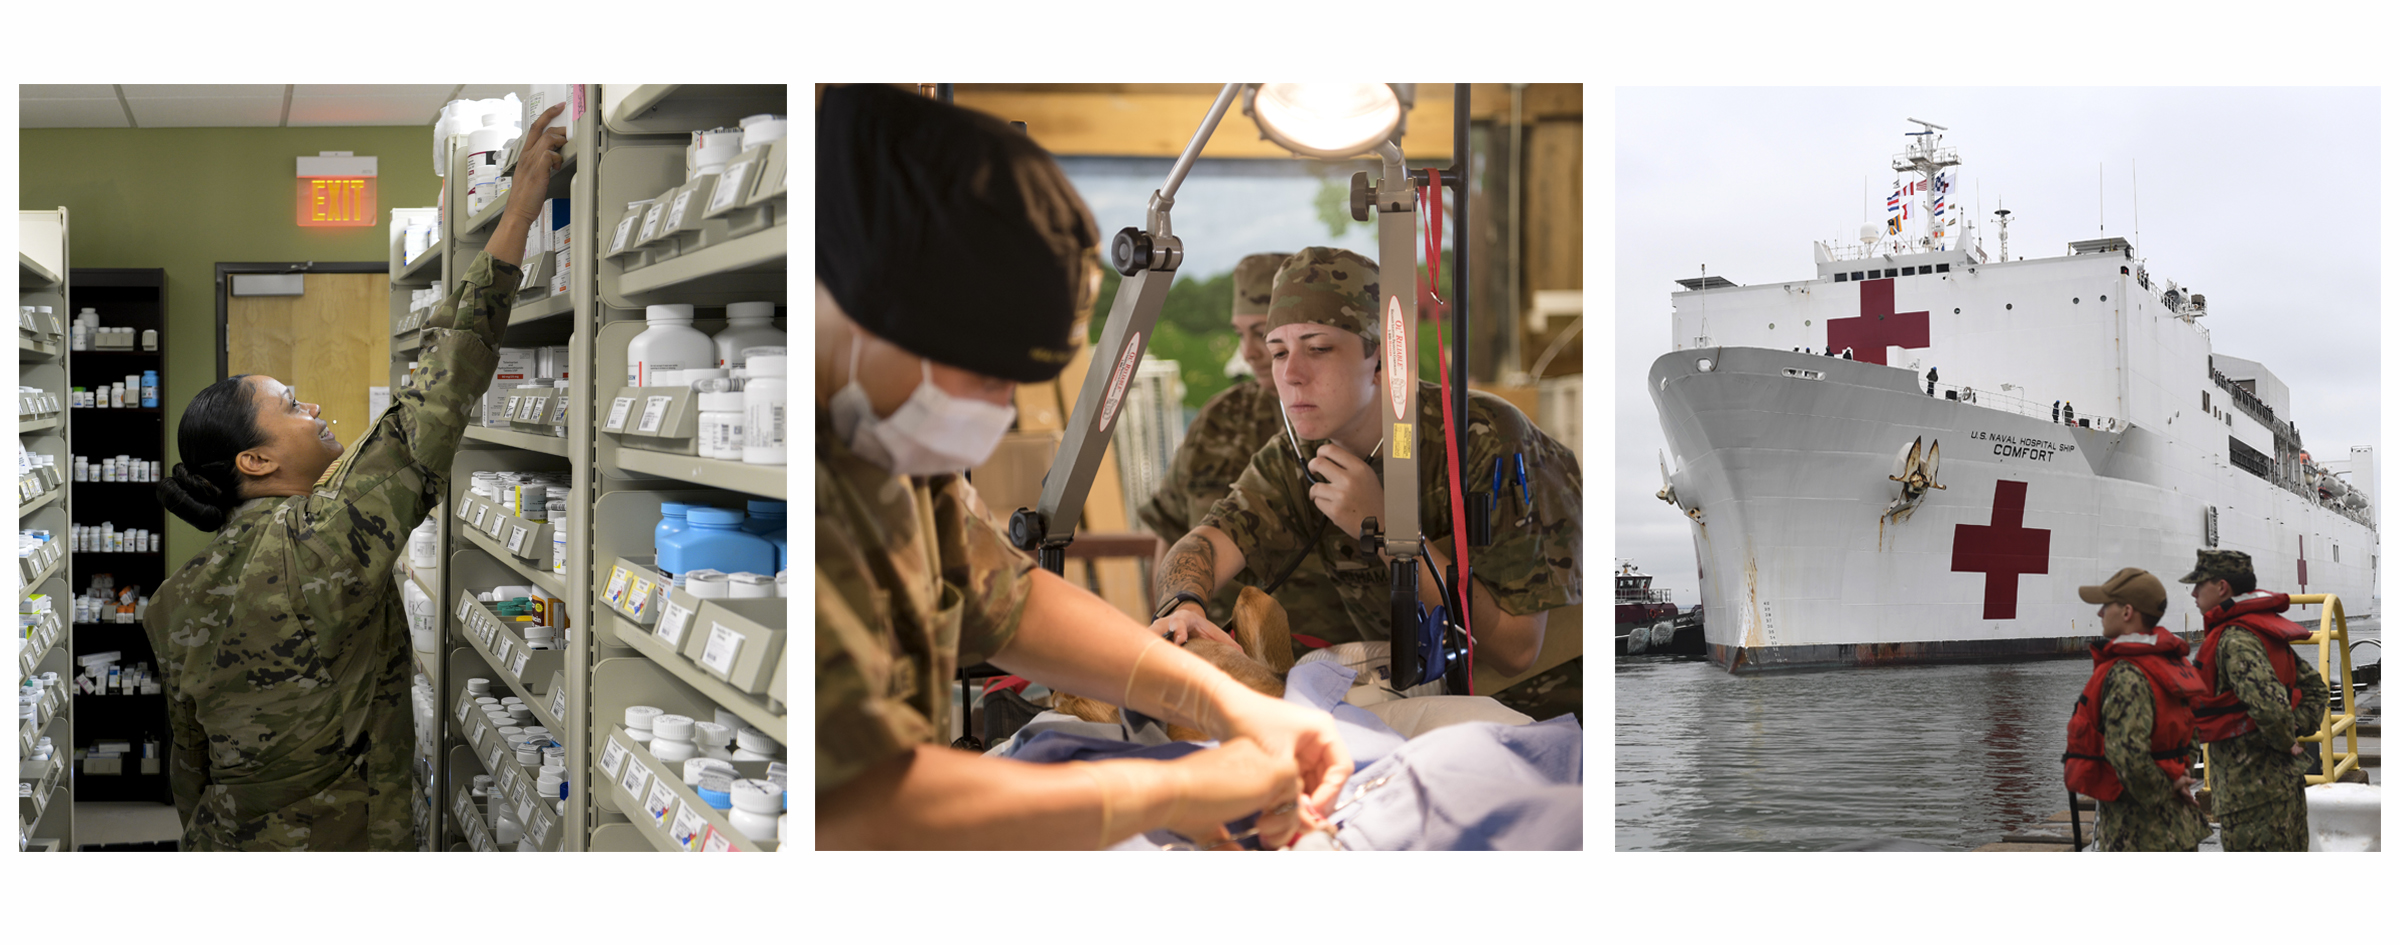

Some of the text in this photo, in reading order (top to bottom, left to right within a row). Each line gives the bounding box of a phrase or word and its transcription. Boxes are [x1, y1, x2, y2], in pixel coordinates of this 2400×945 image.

[312, 180, 364, 221] EXIT
[1117, 363, 1131, 390] RELIABLE
[1970, 431, 2075, 453] U.S. NAVAL HOSPITAL SHIP
[1993, 443, 2054, 462] COMFORT
